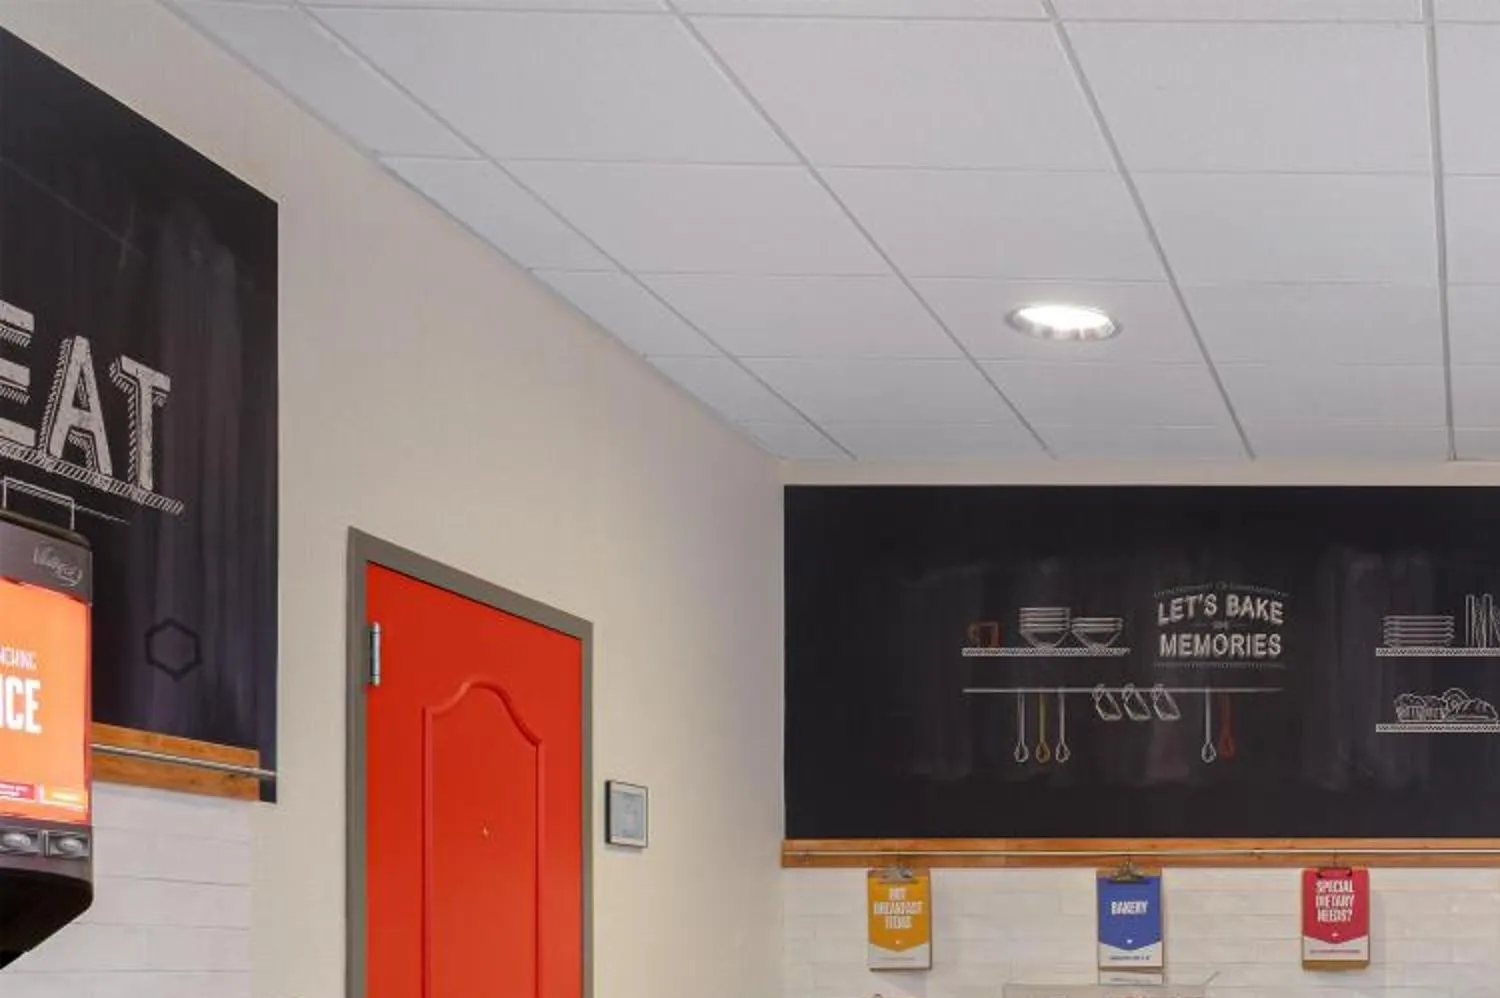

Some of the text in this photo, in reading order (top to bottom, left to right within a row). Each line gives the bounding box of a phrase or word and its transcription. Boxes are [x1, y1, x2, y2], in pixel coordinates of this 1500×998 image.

[1157, 593, 1284, 626] LET'S BAKE
[1158, 632, 1282, 659] MEMORIES
[1110, 901, 1149, 916] BAKERY
